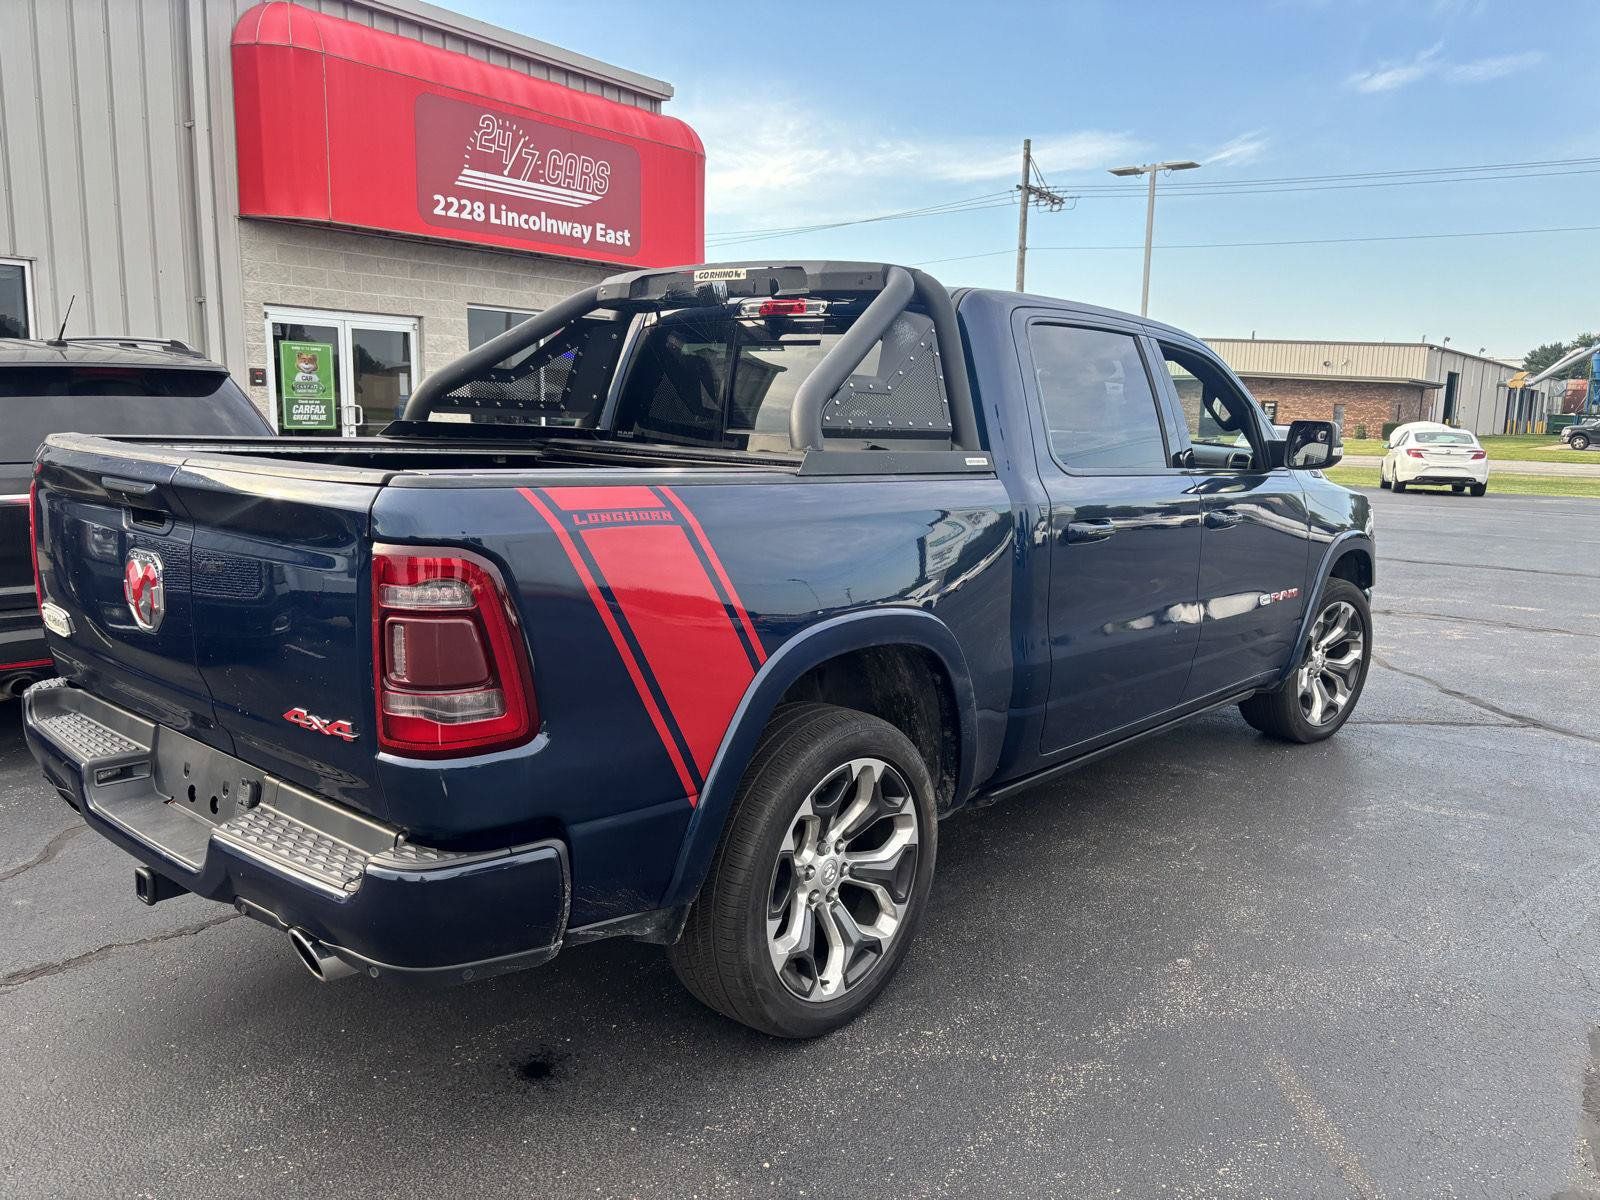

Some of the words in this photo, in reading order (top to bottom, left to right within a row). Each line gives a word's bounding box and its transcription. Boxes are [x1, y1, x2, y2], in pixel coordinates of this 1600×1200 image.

[545, 149, 611, 195] CARS
[432, 194, 485, 222] 2228
[489, 204, 593, 245] Lincolnway
[595, 222, 631, 247] East
[292, 404, 326, 414] CARFAX
[573, 510, 675, 526] LONGHORN
